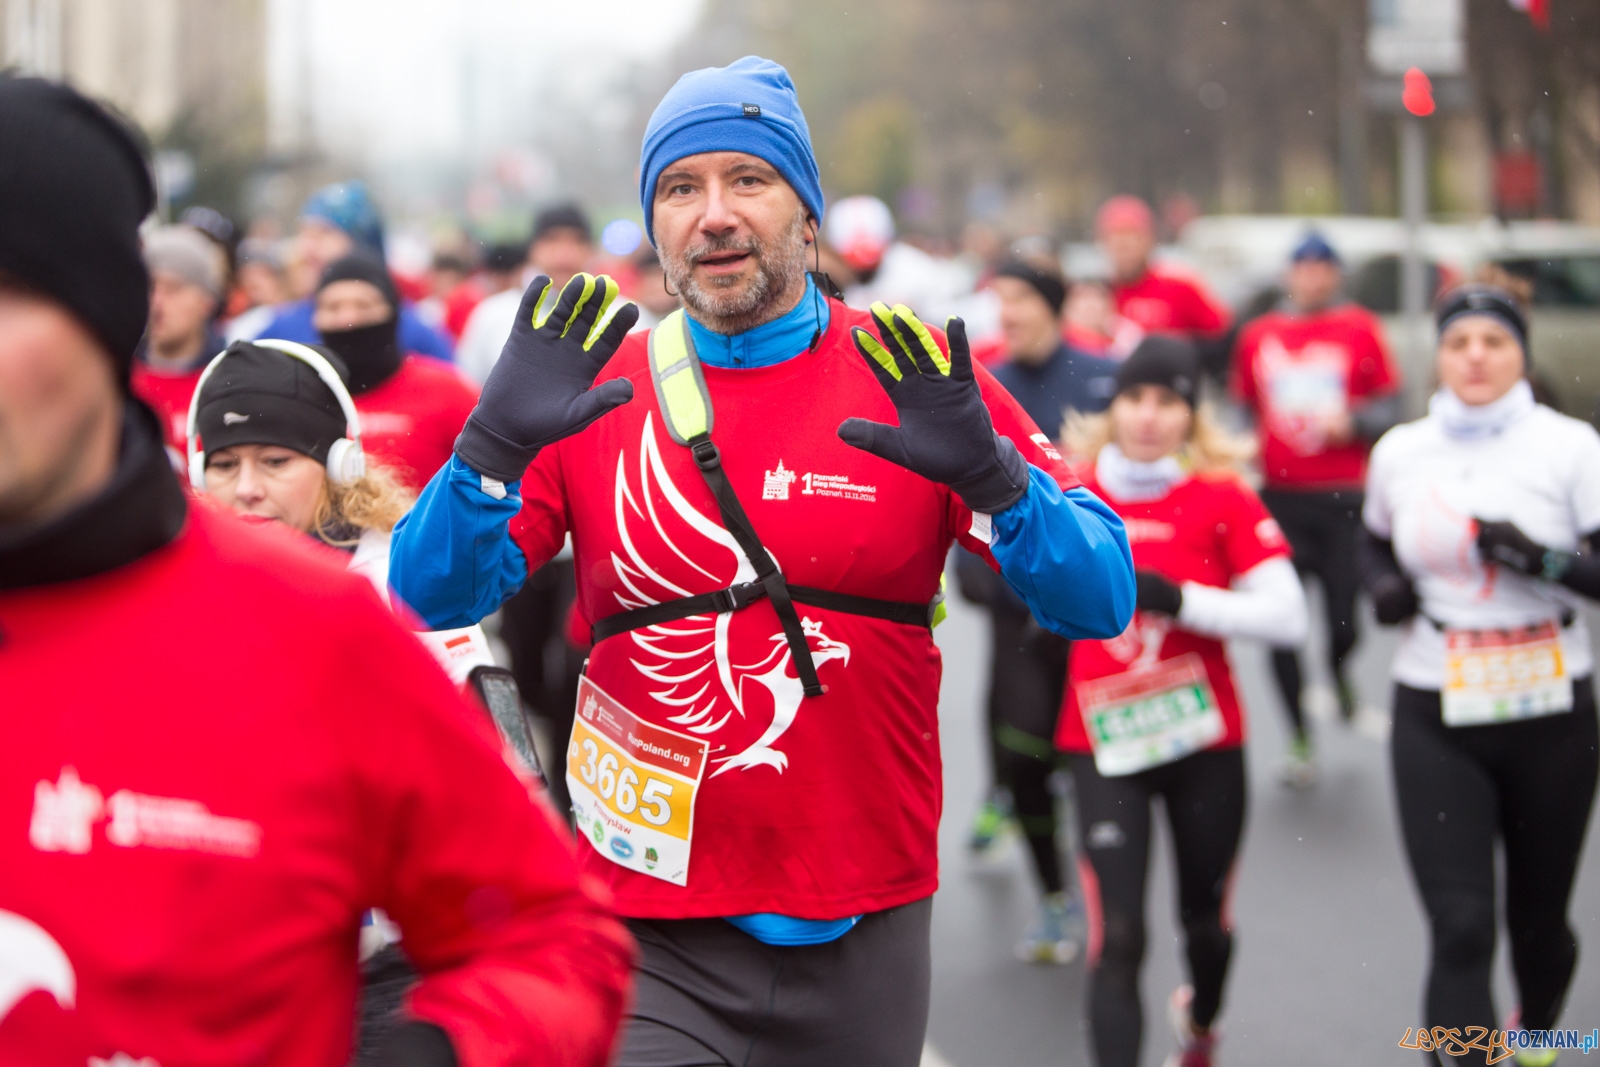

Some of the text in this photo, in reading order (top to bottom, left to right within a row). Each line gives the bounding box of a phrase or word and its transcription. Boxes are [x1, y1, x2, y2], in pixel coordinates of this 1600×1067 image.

[801, 472, 814, 495] 1
[812, 480, 828, 489] Bieg
[813, 474, 848, 483] Poznański
[844, 491, 876, 502] 11.11.2016
[627, 732, 691, 767] RunPoland.org
[580, 738, 672, 826] 3665
